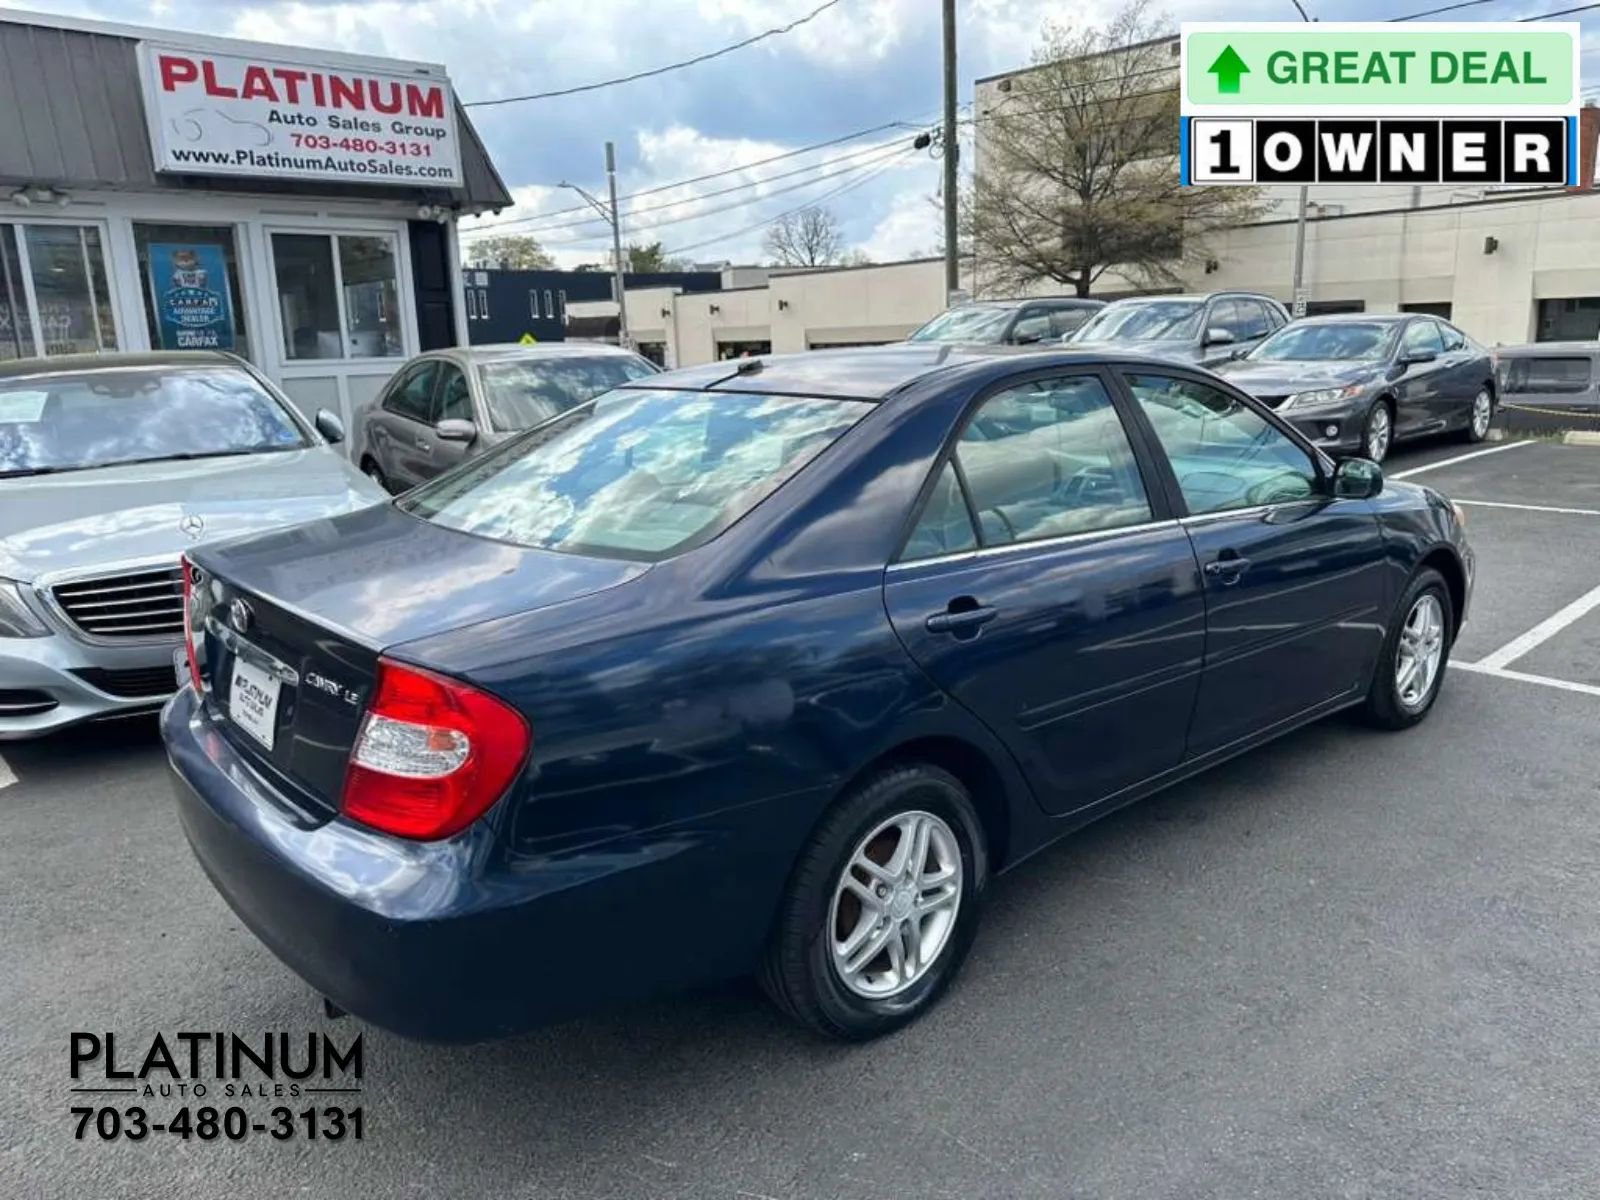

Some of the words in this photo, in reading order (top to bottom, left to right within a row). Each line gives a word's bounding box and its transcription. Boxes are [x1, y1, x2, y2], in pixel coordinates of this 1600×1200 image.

[158, 55, 445, 119] PLATINUM
[268, 109, 317, 127] Auto
[328, 115, 382, 133] Sales
[391, 121, 447, 140] Group
[290, 133, 431, 157] 703-480-3131
[171, 147, 454, 179] www.PlatinumAutoSales.com
[177, 336, 218, 347] CARFAX
